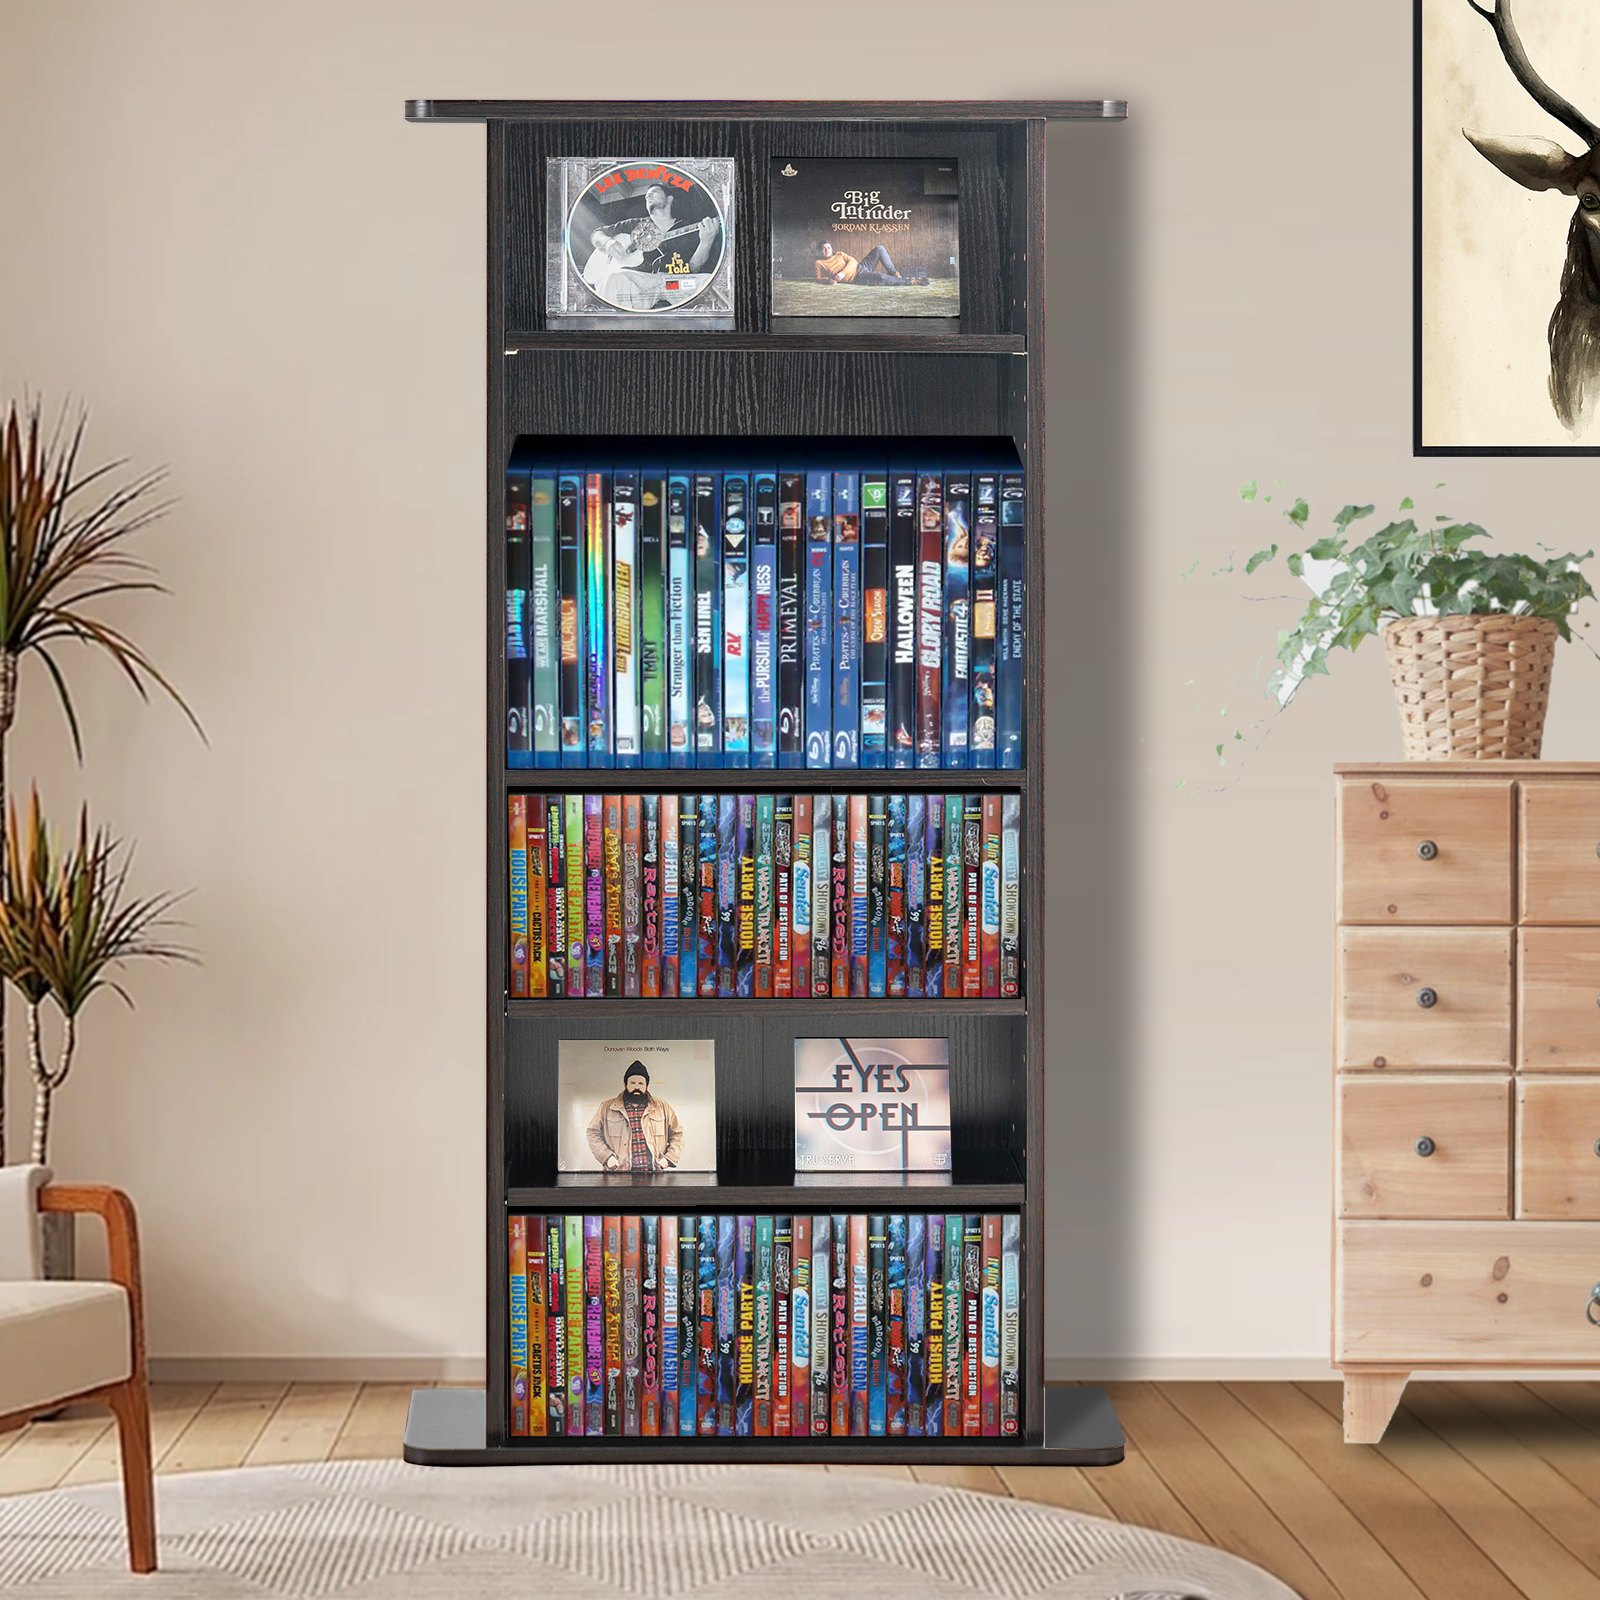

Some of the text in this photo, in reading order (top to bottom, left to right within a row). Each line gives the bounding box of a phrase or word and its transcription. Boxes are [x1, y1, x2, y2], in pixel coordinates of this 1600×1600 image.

[595, 165, 695, 193] LEE DEWYZE
[831, 202, 912, 220] Intruder
[844, 190, 881, 207] Big
[831, 223, 910, 234] JORDAN KLASSEN
[665, 263, 690, 274] Told
[534, 563, 548, 636] MARSHALL
[561, 598, 576, 660] VACANCY
[697, 590, 712, 654] SENTINEL
[756, 565, 770, 631] HAPPYNESS
[780, 572, 798, 663] PRIMEVAL
[810, 568, 821, 671] PIRATES CARIBBEAN
[838, 560, 850, 670] PIRATES CARIBBEAN
[870, 590, 883, 641] OPEN SEASON
[896, 565, 914, 664] HALLOWEEN
[921, 561, 941, 668] GLORY ROAD
[1013, 580, 1022, 658] ENEMY OF THE STATE
[507, 624, 527, 659] WILD
[642, 639, 658, 682] TMNT
[669, 576, 684, 698] Stranger than Fiction
[756, 641, 770, 688] PURSUIT
[954, 603, 968, 680] FANTASTIC 4
[511, 850, 527, 934] HOUSE PARTY
[567, 842, 584, 939] HOUSE PARTY
[586, 814, 602, 934] NOVEMBER REMEMBER
[662, 840, 678, 892] BUFFALO
[852, 840, 867, 892] BUFFALO
[606, 883, 620, 928] PHILLY
[662, 896, 678, 956] INVASION
[741, 856, 754, 950] HOUSE PARTY
[779, 872, 788, 960] PATH OF DESTRUCTION
[817, 882, 828, 934] SHOWDOWN
[852, 896, 867, 956] INVASION
[930, 856, 944, 950] HOUSE PARTY
[968, 872, 978, 960] PATH OF DESTRUCTION
[1006, 882, 1017, 934] SHOWDOWN
[532, 912, 542, 962] CACTUS JACK
[832, 1064, 910, 1092] EYES
[826, 1103, 918, 1132] OPEN
[510, 1275, 526, 1368] HOUSE PARTY
[566, 1268, 583, 1373] HOUSE PARTY
[586, 1237, 601, 1368] NOVEMBER REMEMBER
[662, 1266, 677, 1322] BUFFALO
[852, 1266, 867, 1322] BUFFALO
[605, 1312, 619, 1360] PHILLY
[662, 1327, 677, 1391] INVASION
[740, 1282, 754, 1384] HOUSE PARTY
[778, 1300, 788, 1396] PATH OF DESTRUCTION
[816, 1311, 827, 1368] SHOWDOWN
[852, 1327, 867, 1391] INVASION
[930, 1282, 944, 1384] HOUSE PARTY
[968, 1300, 978, 1396] PATH OF DESTRUCTION
[1006, 1311, 1017, 1368] SHOWDOWN
[531, 1344, 541, 1398] CACTUS JACK
